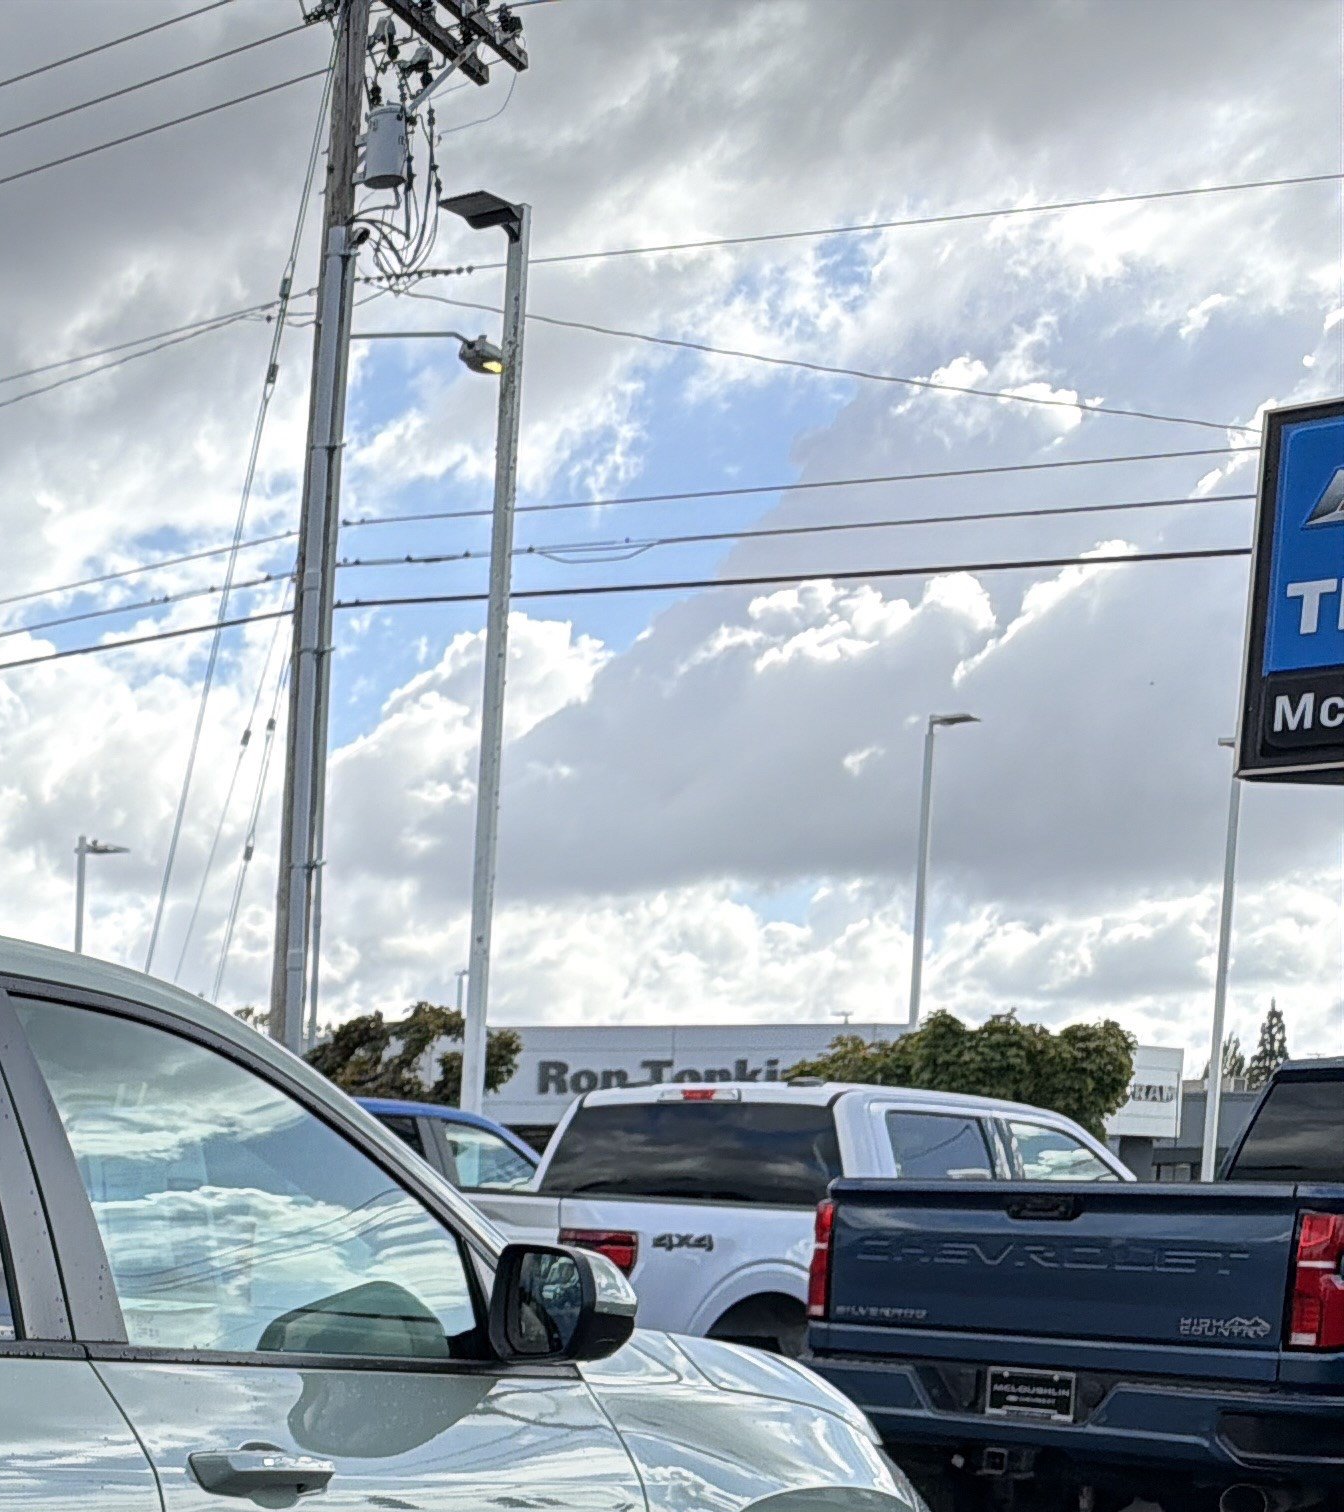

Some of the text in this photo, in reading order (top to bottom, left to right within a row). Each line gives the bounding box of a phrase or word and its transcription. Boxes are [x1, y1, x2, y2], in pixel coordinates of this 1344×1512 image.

[1286, 576, 1344, 635] T
[538, 1058, 800, 1094] Ron Tonki
[857, 1240, 1250, 1276] CHEVROLET
